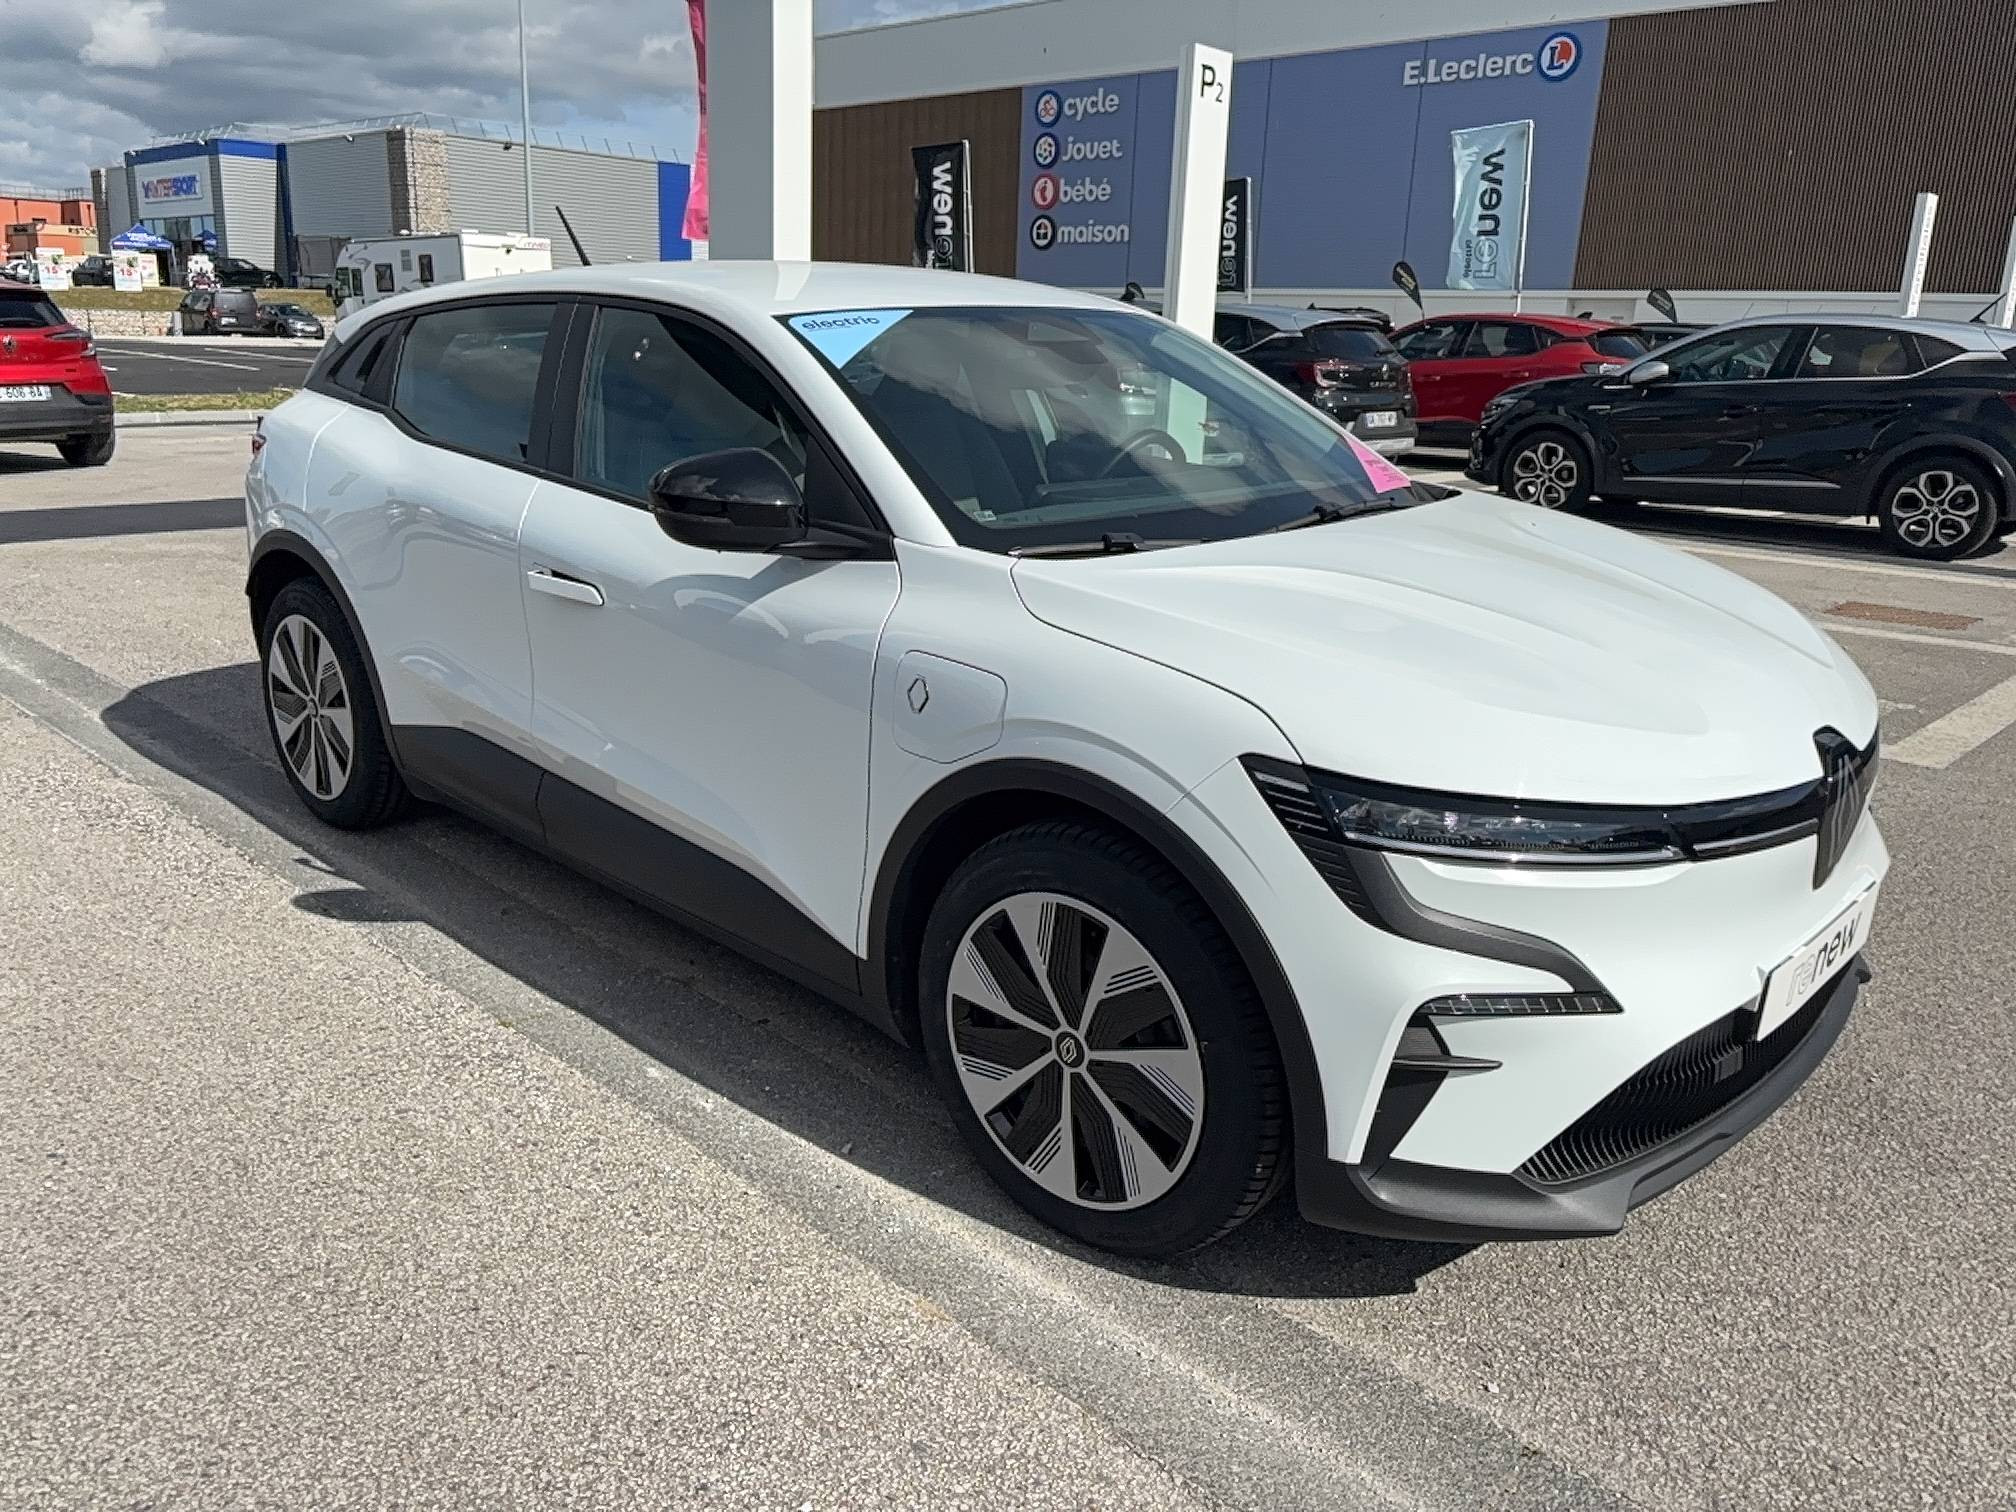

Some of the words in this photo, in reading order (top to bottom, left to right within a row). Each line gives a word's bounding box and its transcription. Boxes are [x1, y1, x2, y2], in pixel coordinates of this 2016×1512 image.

[1402, 53, 1536, 86] E.Leclerc
[1063, 88, 1120, 121] cycle
[1061, 136, 1123, 161] jouet
[1059, 177, 1112, 202] bébé
[1056, 220, 1130, 244] maison
[802, 315, 881, 331] electric
[1786, 912, 1863, 1007] renew
